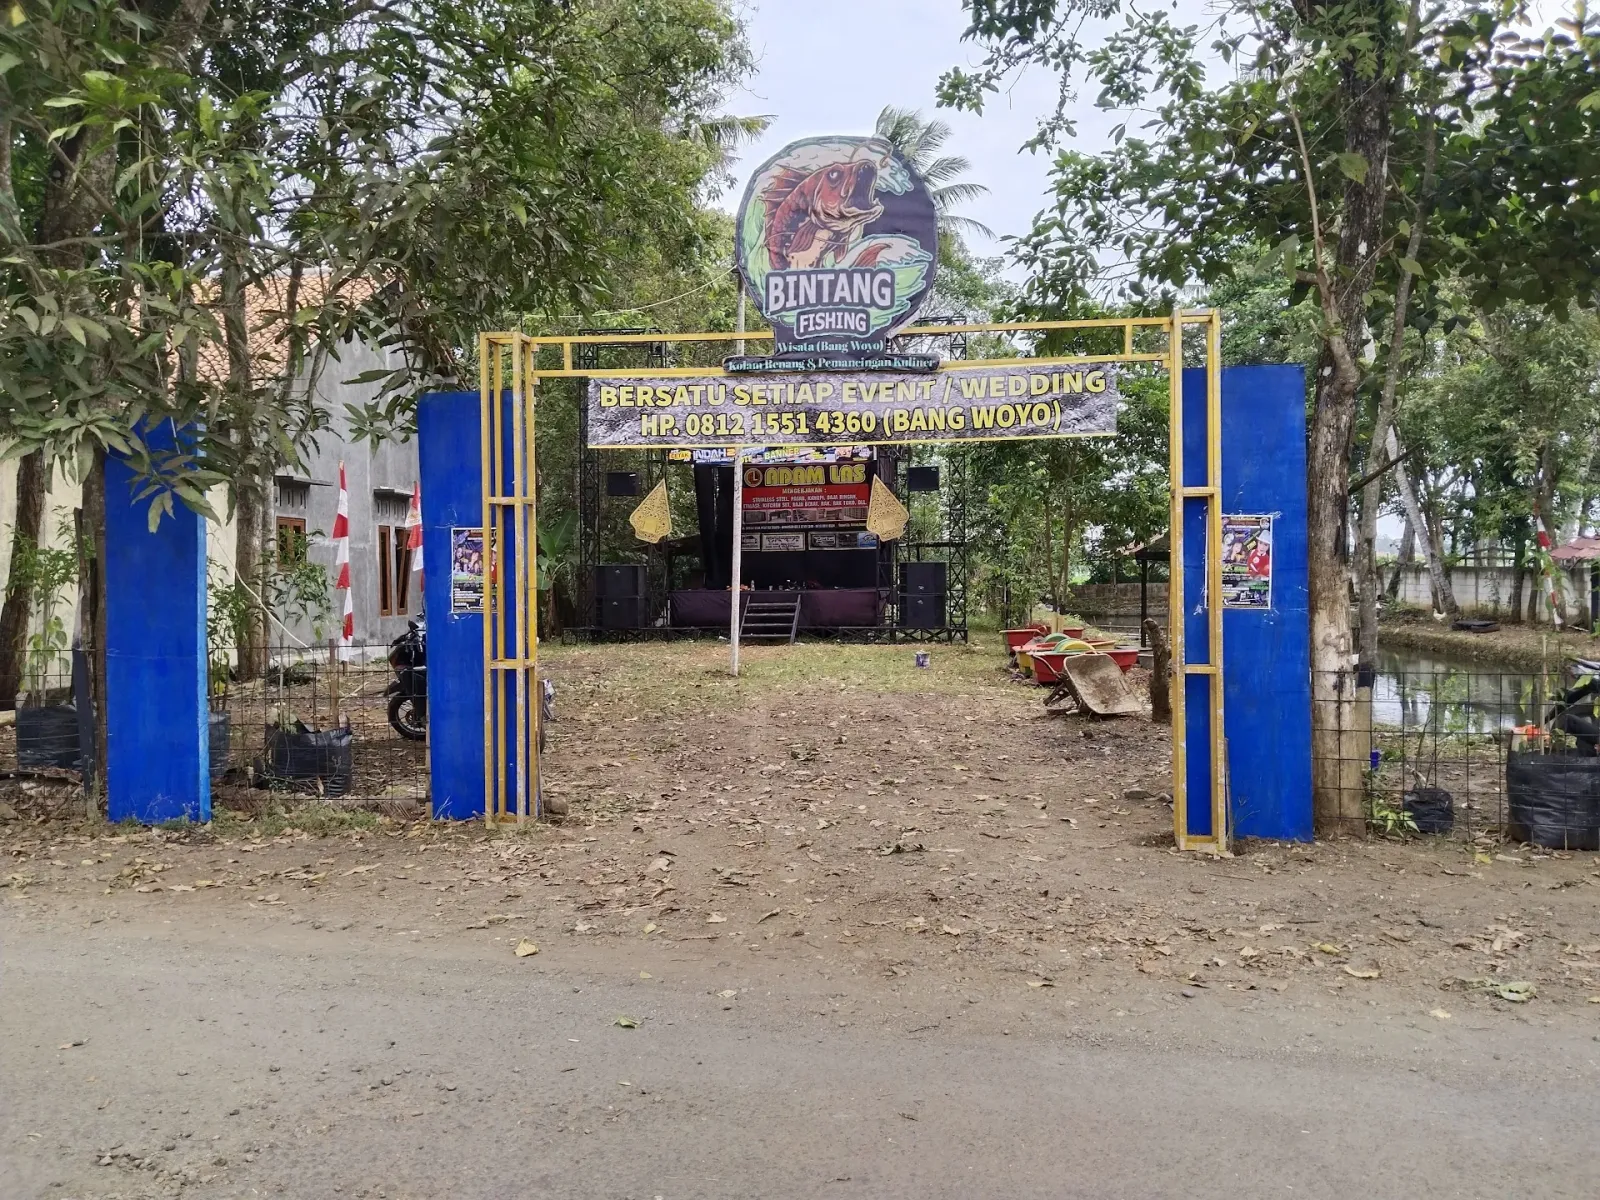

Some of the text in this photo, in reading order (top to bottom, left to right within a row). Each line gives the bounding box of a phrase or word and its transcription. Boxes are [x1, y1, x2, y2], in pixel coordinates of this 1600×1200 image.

[768, 271, 893, 313] BINTANG
[799, 311, 867, 334] FISHING
[777, 340, 884, 354] Wisata (Bang Woyo)
[729, 357, 935, 371] Kolam Renang & Pemancingan Kuliner
[600, 371, 1107, 407] BERSATU SETIAP EVENT / WEDDING
[640, 399, 1061, 437] HP. 0812 1551 4360 (BANG WOYO)
[692, 448, 726, 460] INDAH
[765, 464, 866, 486] ADAM LAS
